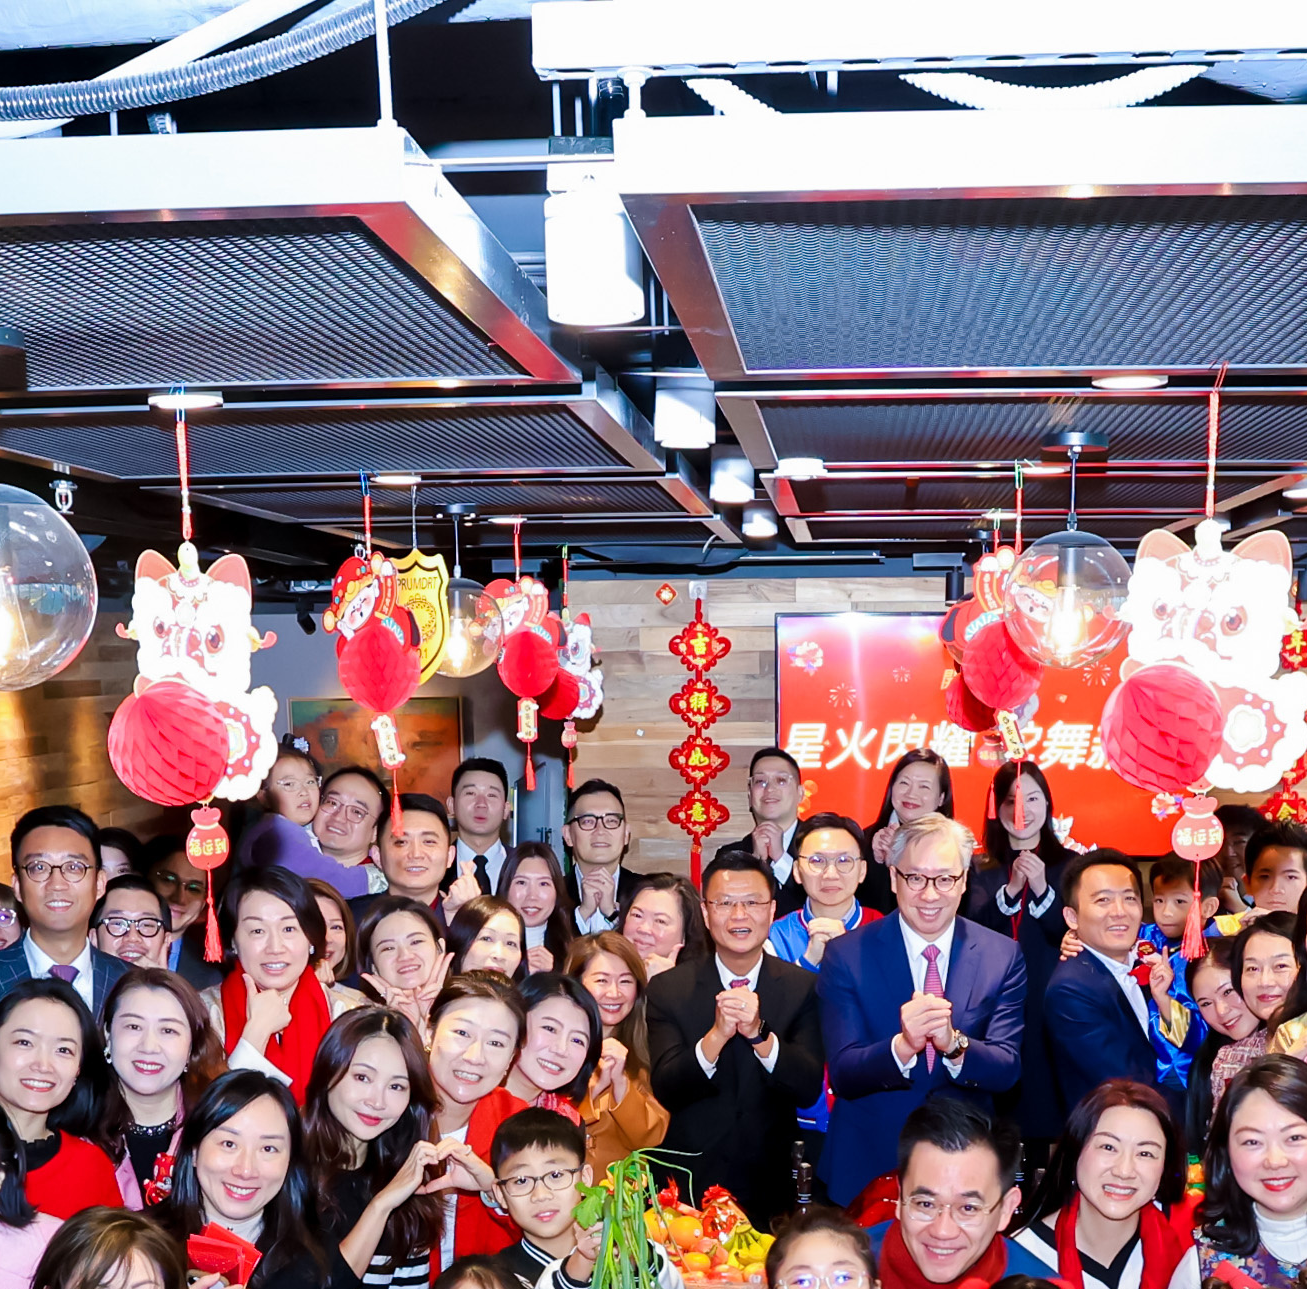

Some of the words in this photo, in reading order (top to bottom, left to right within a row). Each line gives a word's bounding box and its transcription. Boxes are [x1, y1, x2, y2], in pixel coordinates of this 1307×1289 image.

[1176, 827, 1223, 846] 福运到
[189, 838, 227, 857] 福运到
